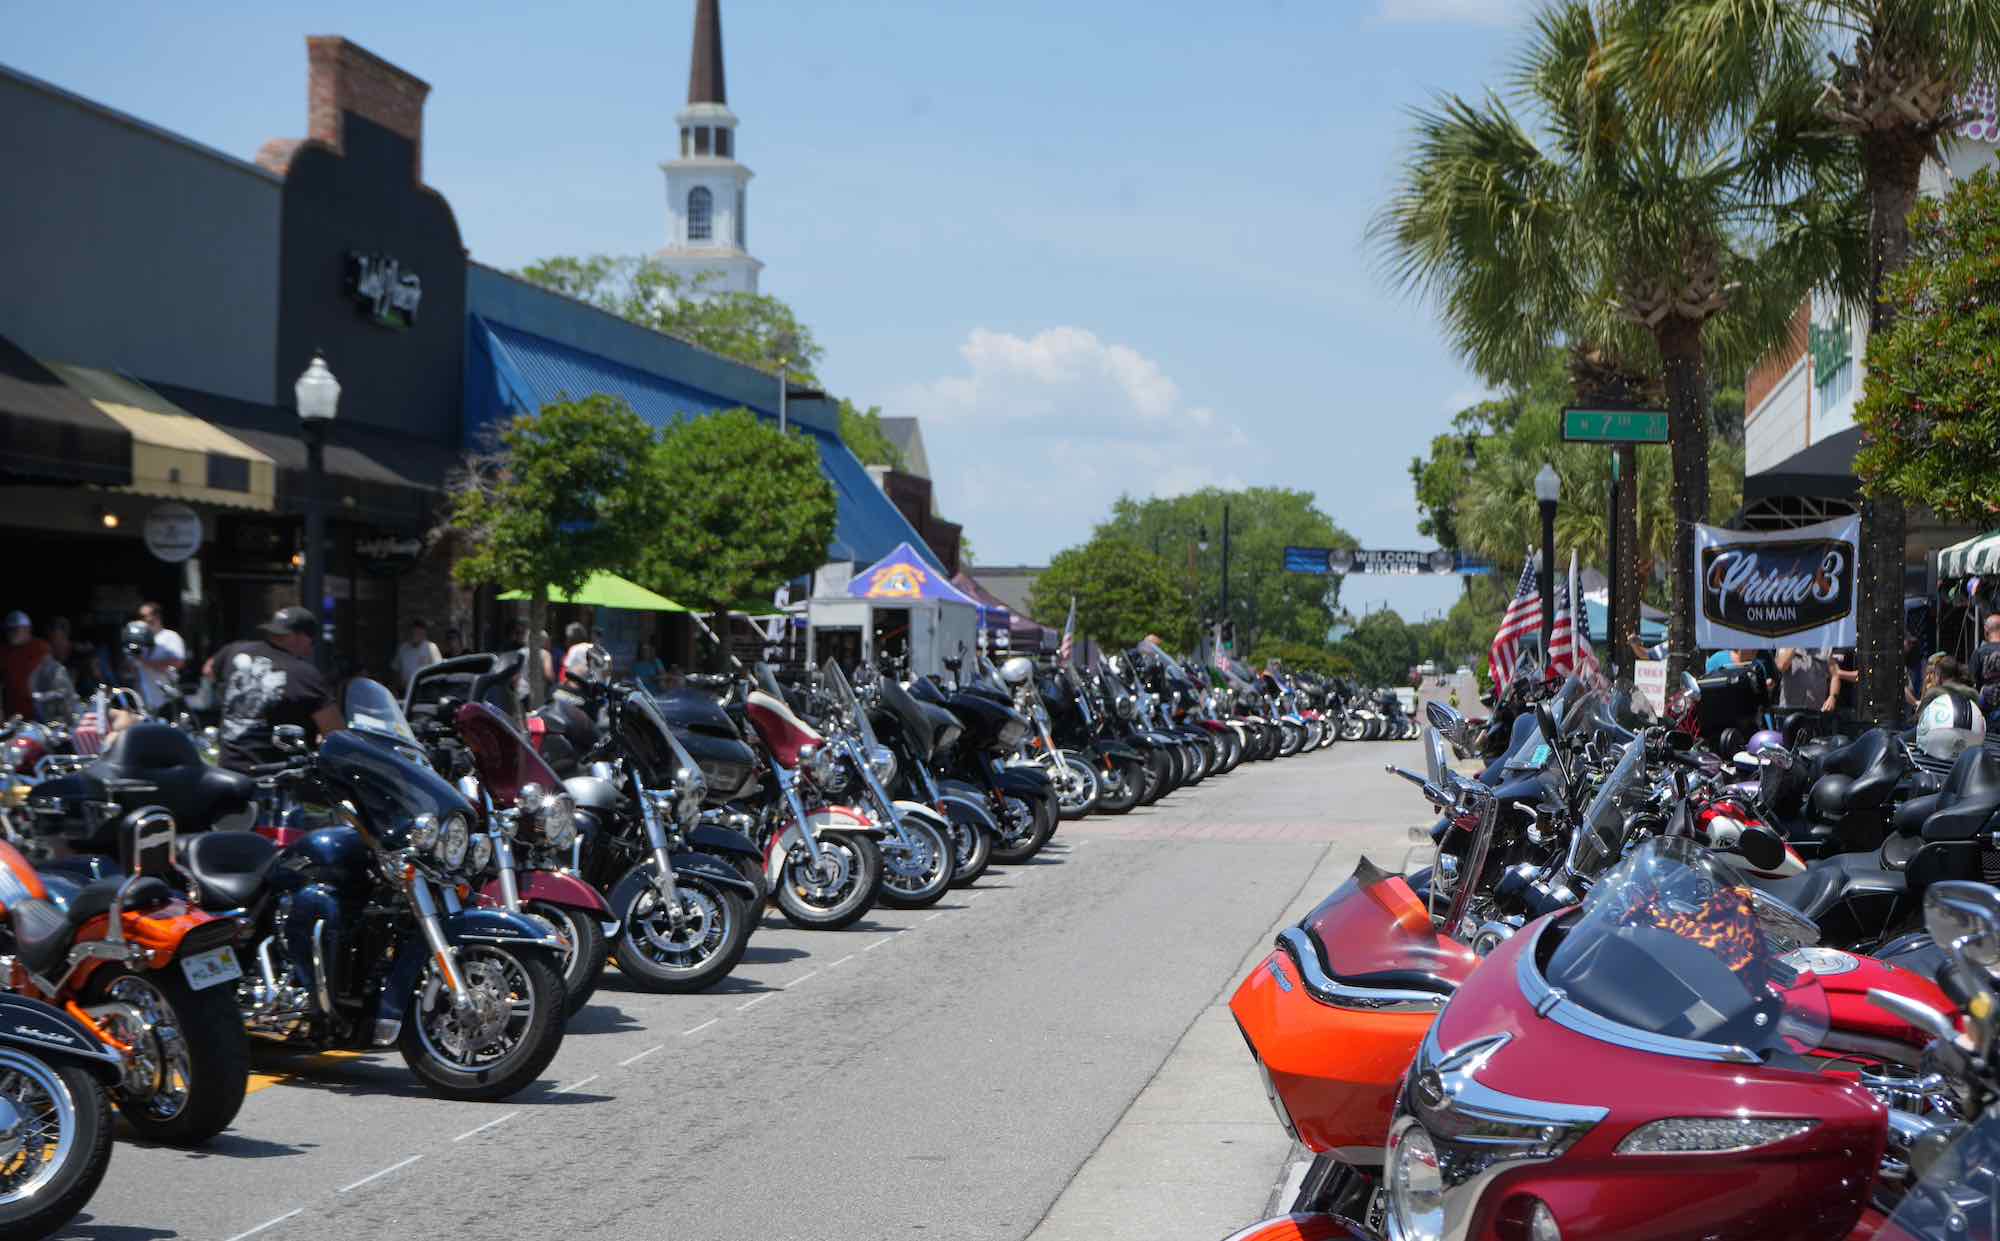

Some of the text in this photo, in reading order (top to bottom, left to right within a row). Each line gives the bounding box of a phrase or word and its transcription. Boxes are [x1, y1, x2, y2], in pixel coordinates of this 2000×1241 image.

[1354, 551, 1428, 564] WELCOME
[1364, 562, 1419, 575] BIKERS
[1747, 607, 1797, 621] ON MAIN
